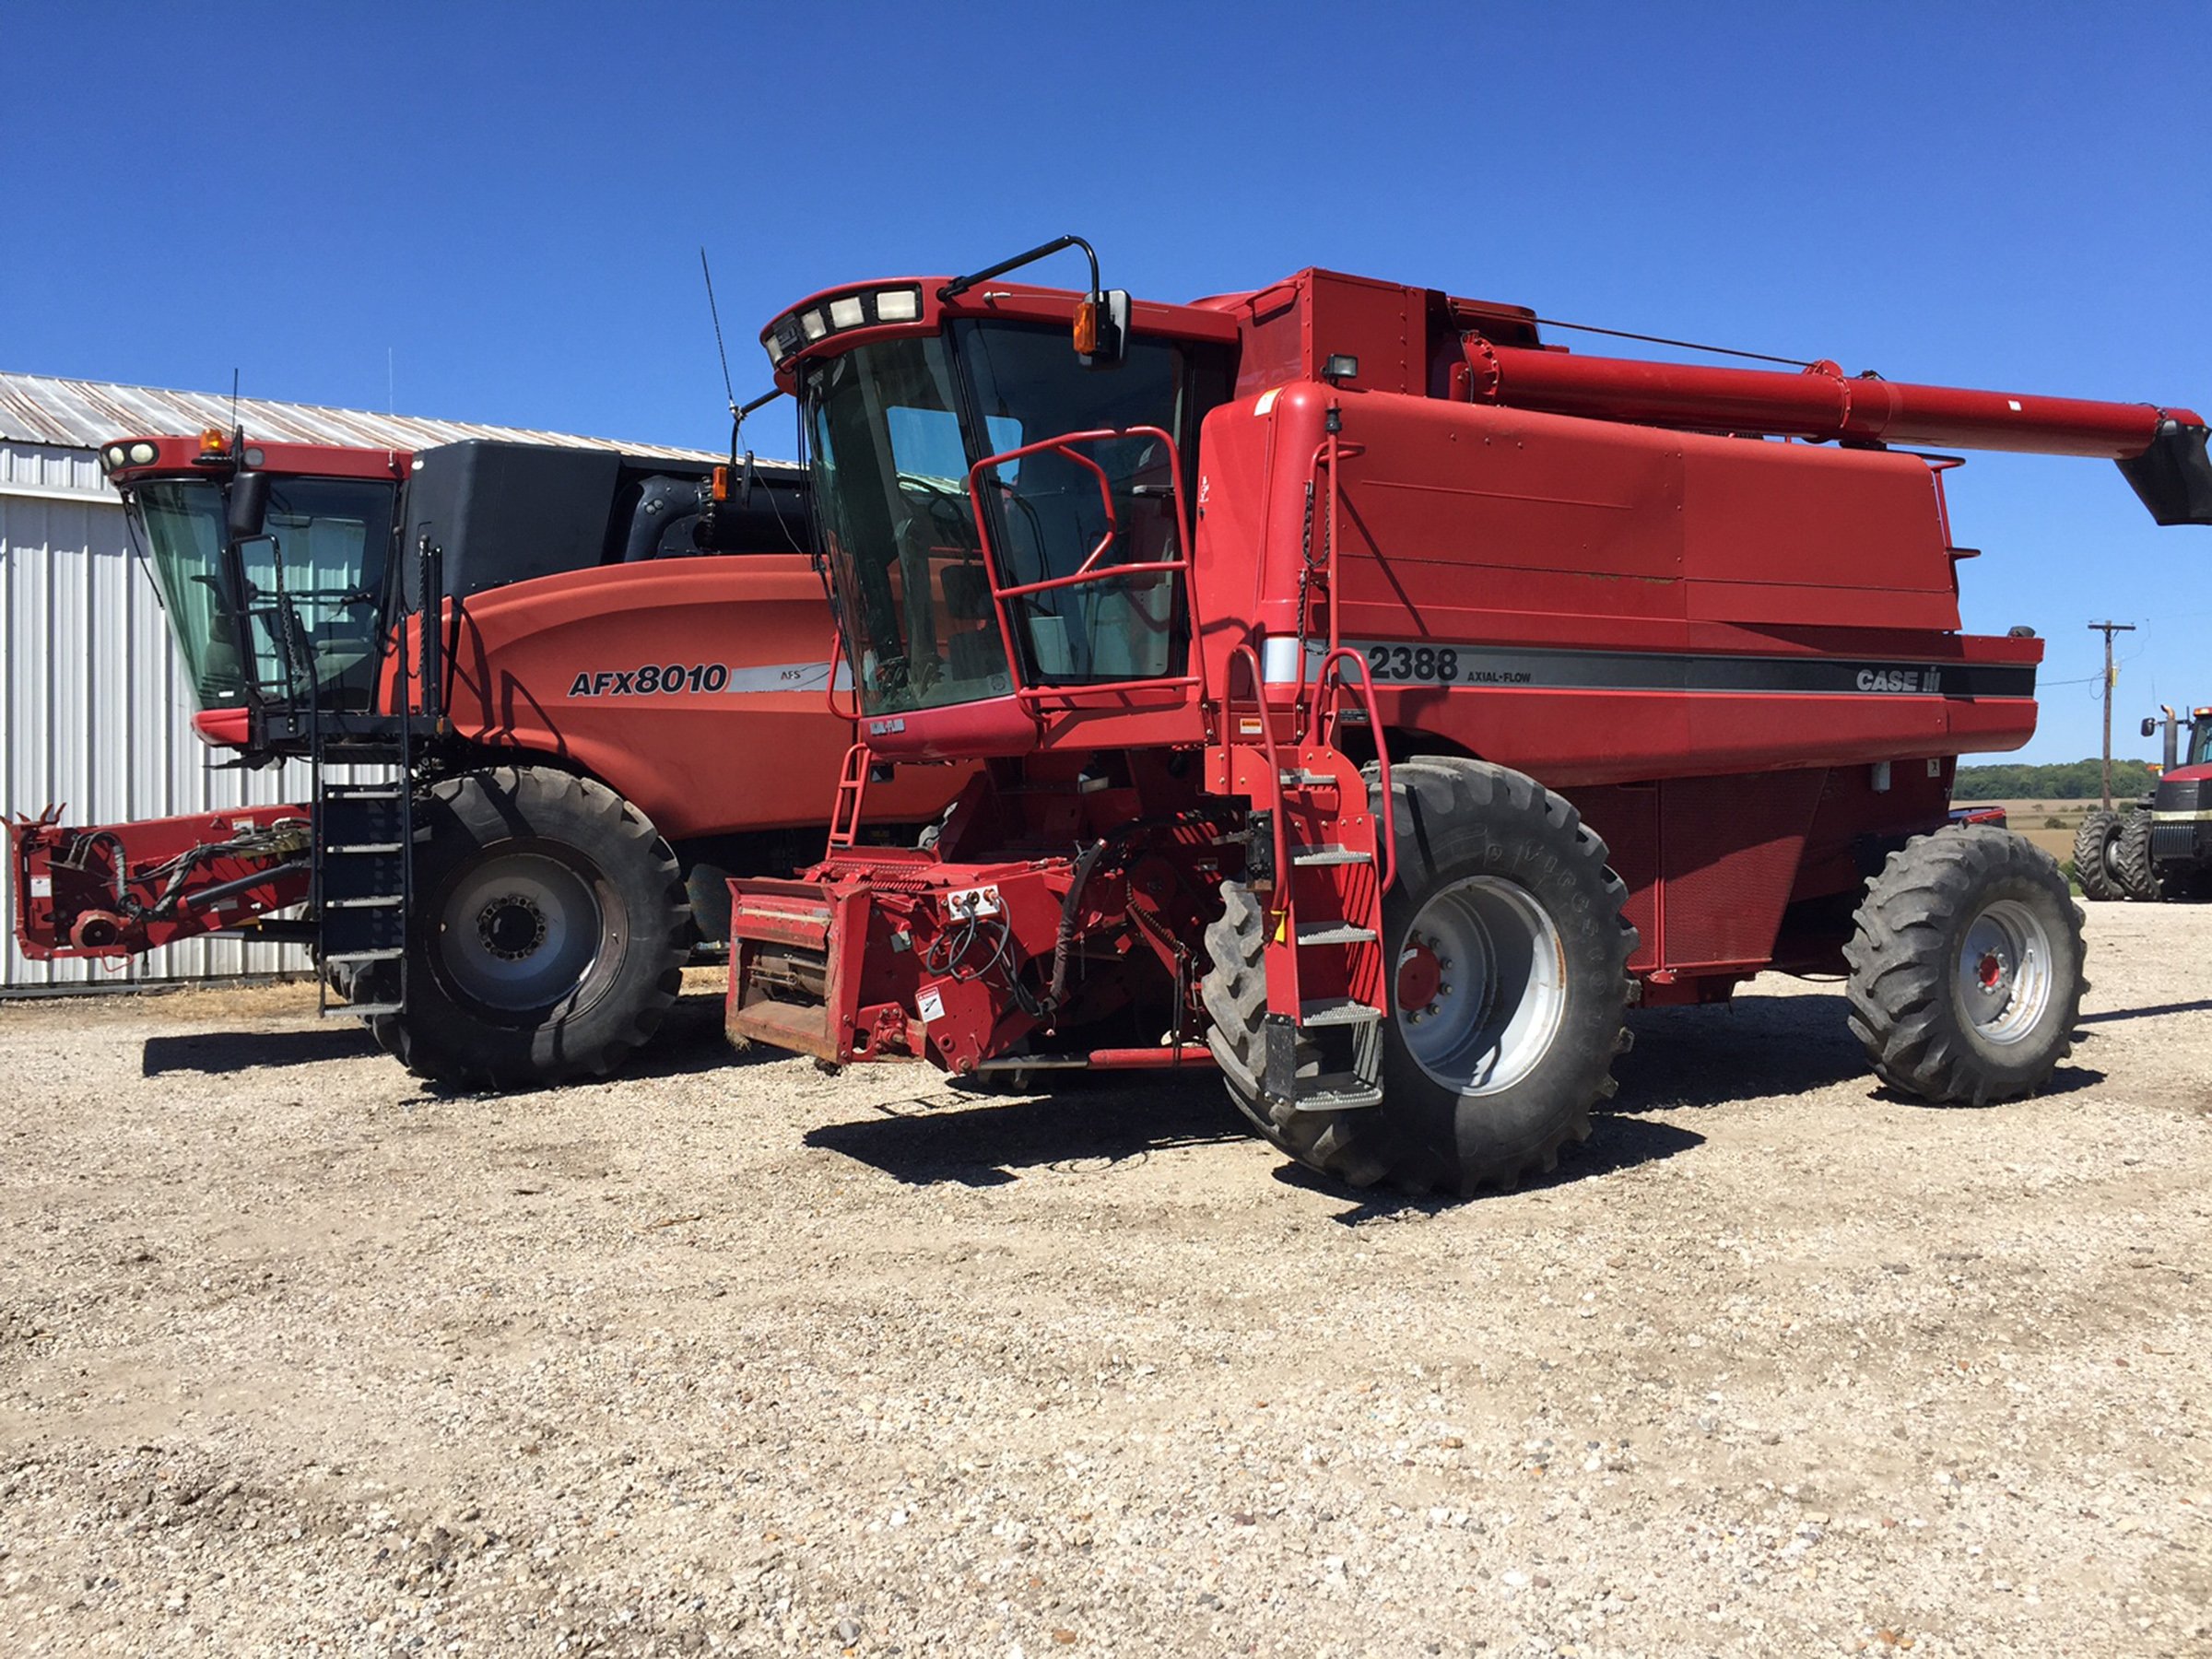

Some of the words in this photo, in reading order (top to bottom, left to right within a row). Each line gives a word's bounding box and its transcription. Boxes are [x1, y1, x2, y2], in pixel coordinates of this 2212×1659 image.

[781, 670, 801, 680] AFS
[1368, 645, 1458, 680] 2388
[568, 664, 727, 697] AFX8010
[1856, 669, 1919, 691] CASE
